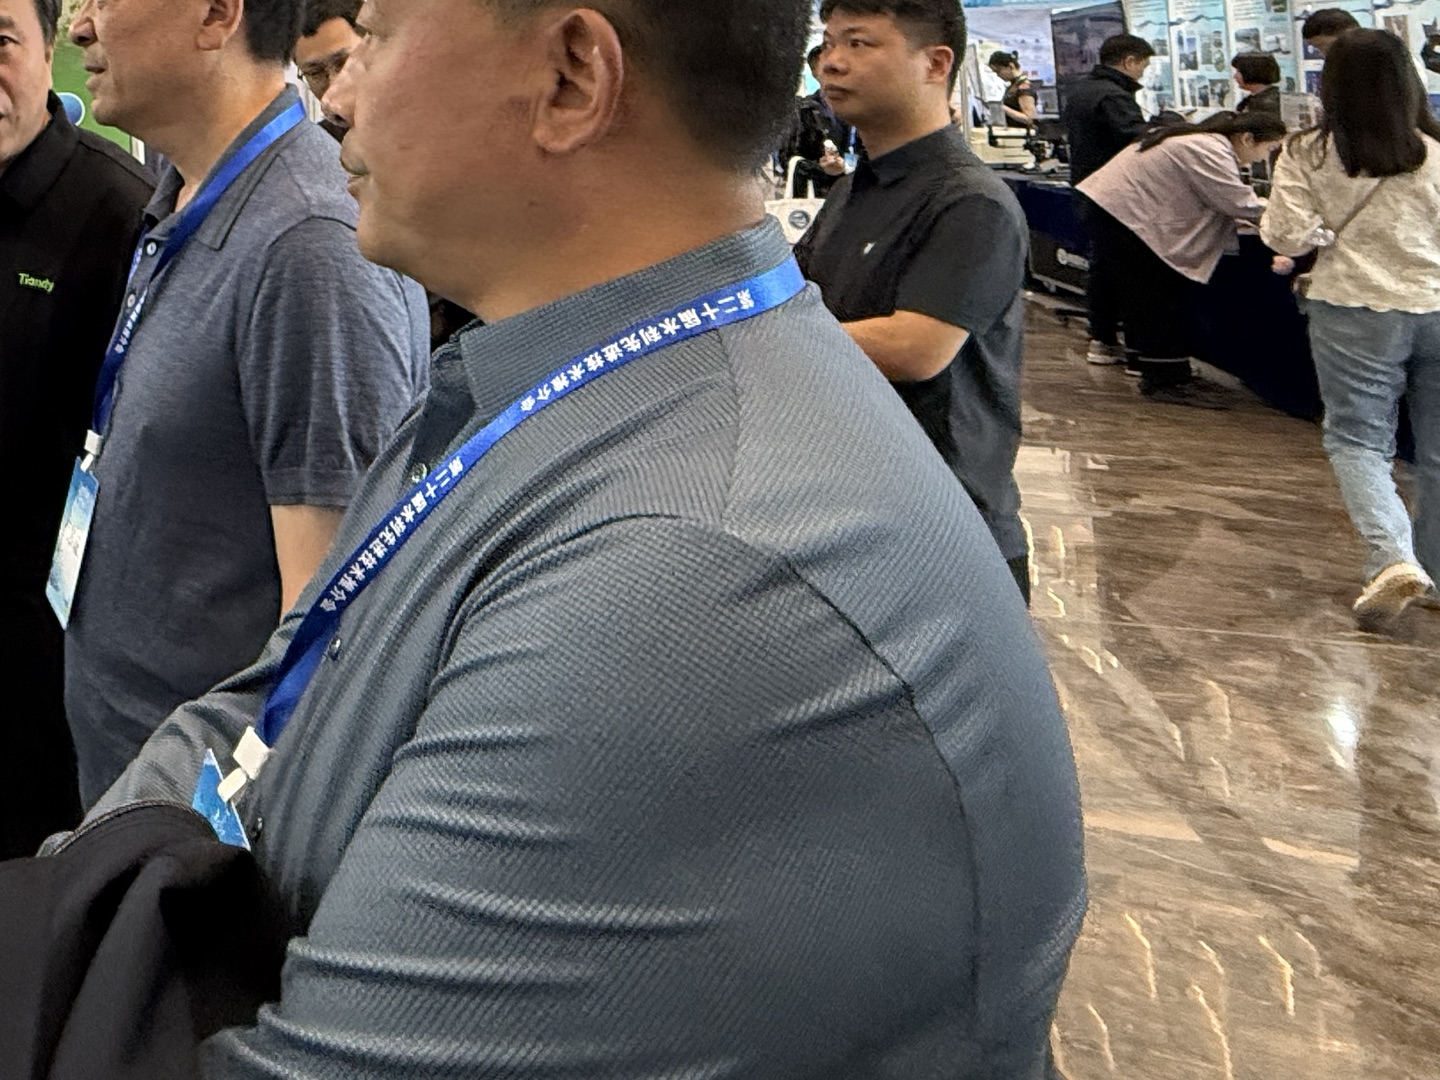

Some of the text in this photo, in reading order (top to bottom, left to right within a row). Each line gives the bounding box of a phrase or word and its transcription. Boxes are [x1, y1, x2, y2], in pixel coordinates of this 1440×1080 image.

[18, 272, 55, 293] Tiandy
[519, 288, 755, 412] 第二十届水利先进技术推介会
